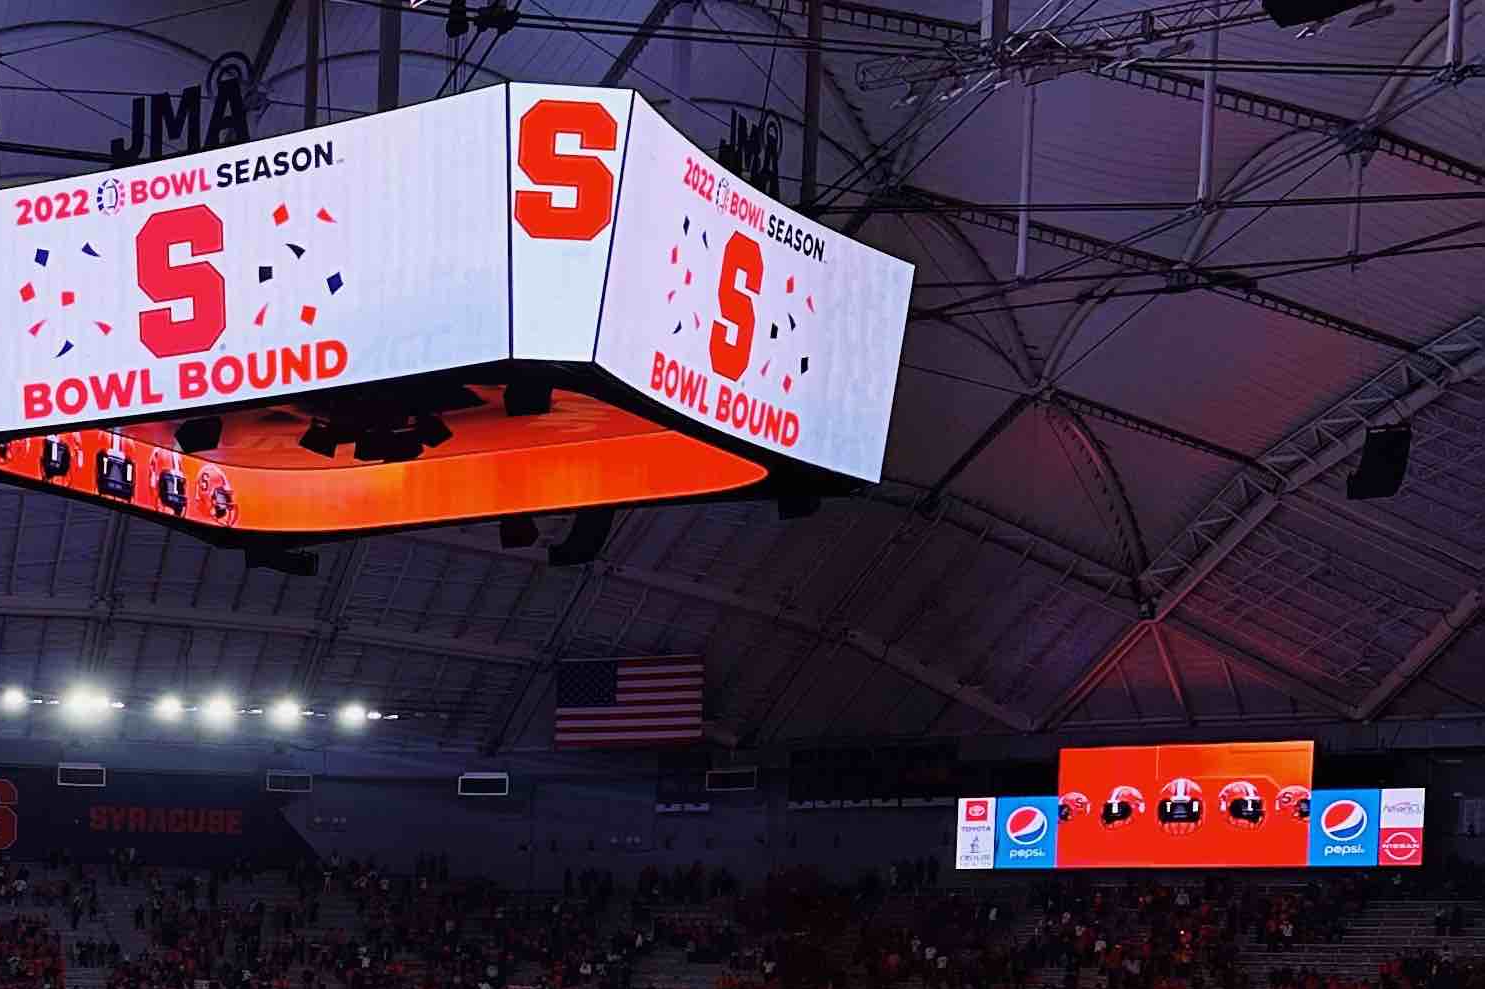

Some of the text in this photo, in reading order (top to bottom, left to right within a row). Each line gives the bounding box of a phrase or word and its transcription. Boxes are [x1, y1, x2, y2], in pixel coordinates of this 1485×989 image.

[111, 76, 252, 161] JMA
[16, 141, 334, 227] 2022 BOWL SEASON
[514, 99, 618, 241] S
[683, 157, 826, 263] 2022 BOWL SEASON
[136, 204, 226, 359] S
[709, 230, 764, 382] S
[23, 340, 348, 420] BOWL BOUND
[649, 350, 800, 448] BOWL BOUND
[89, 805, 243, 835] SYRACUSE
[1009, 848, 1045, 860] pepsi
[1324, 844, 1364, 857] pepsi
